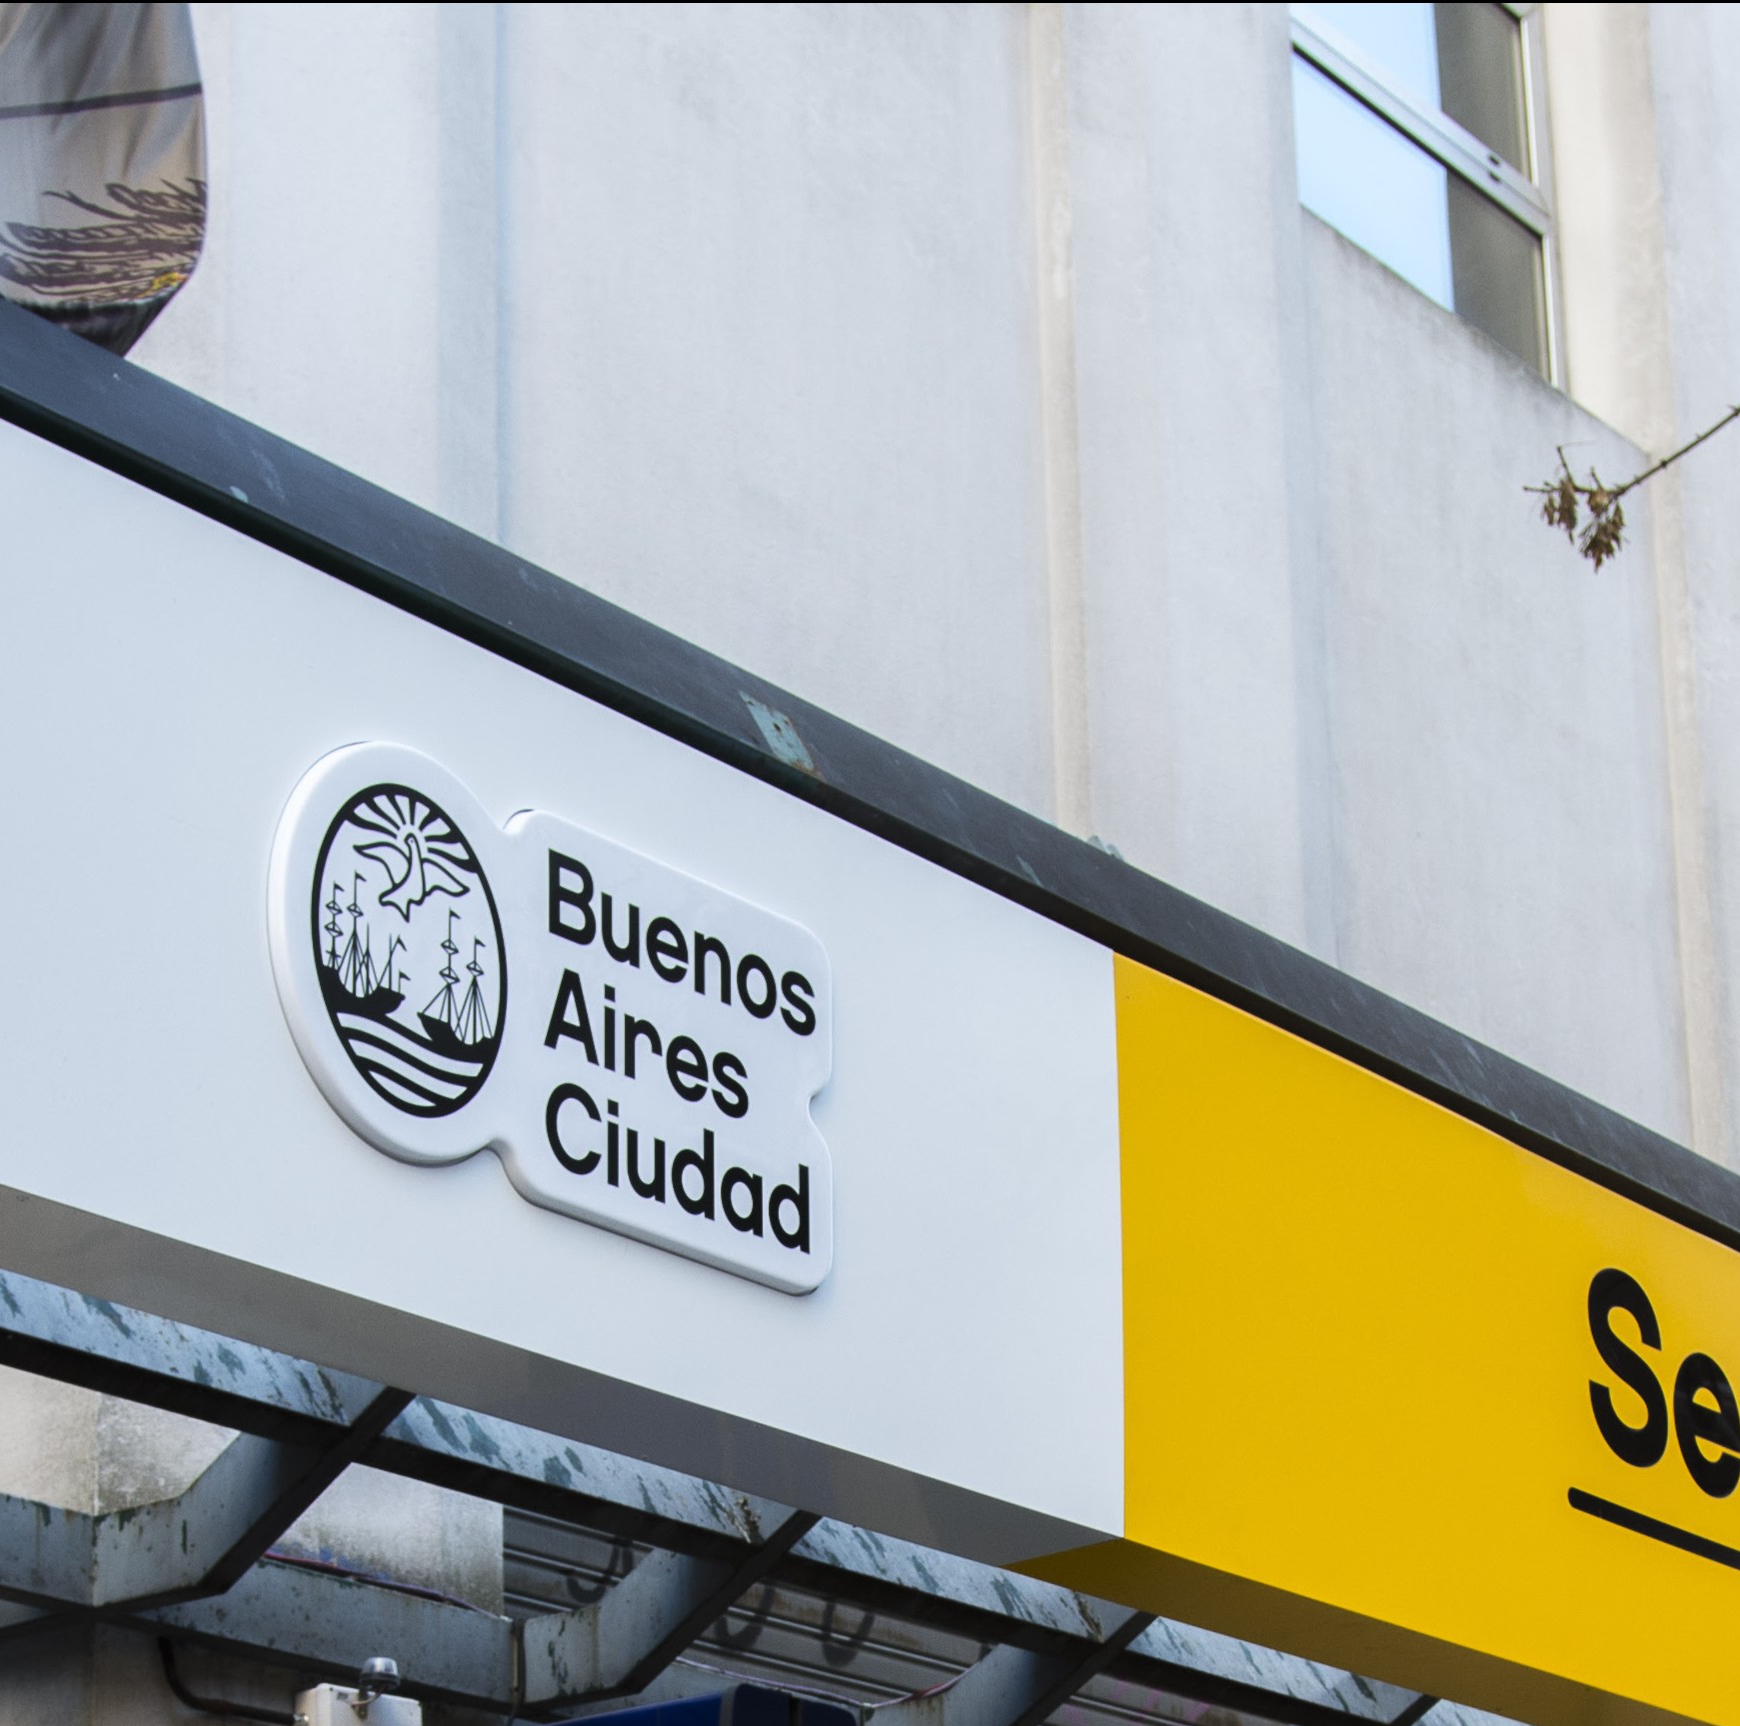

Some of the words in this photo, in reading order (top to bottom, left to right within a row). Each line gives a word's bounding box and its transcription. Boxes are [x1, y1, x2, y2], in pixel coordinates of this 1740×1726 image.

[547, 848, 817, 1036] Buenos
[543, 968, 750, 1120] Aires
[544, 1082, 811, 1255] Ciudad
